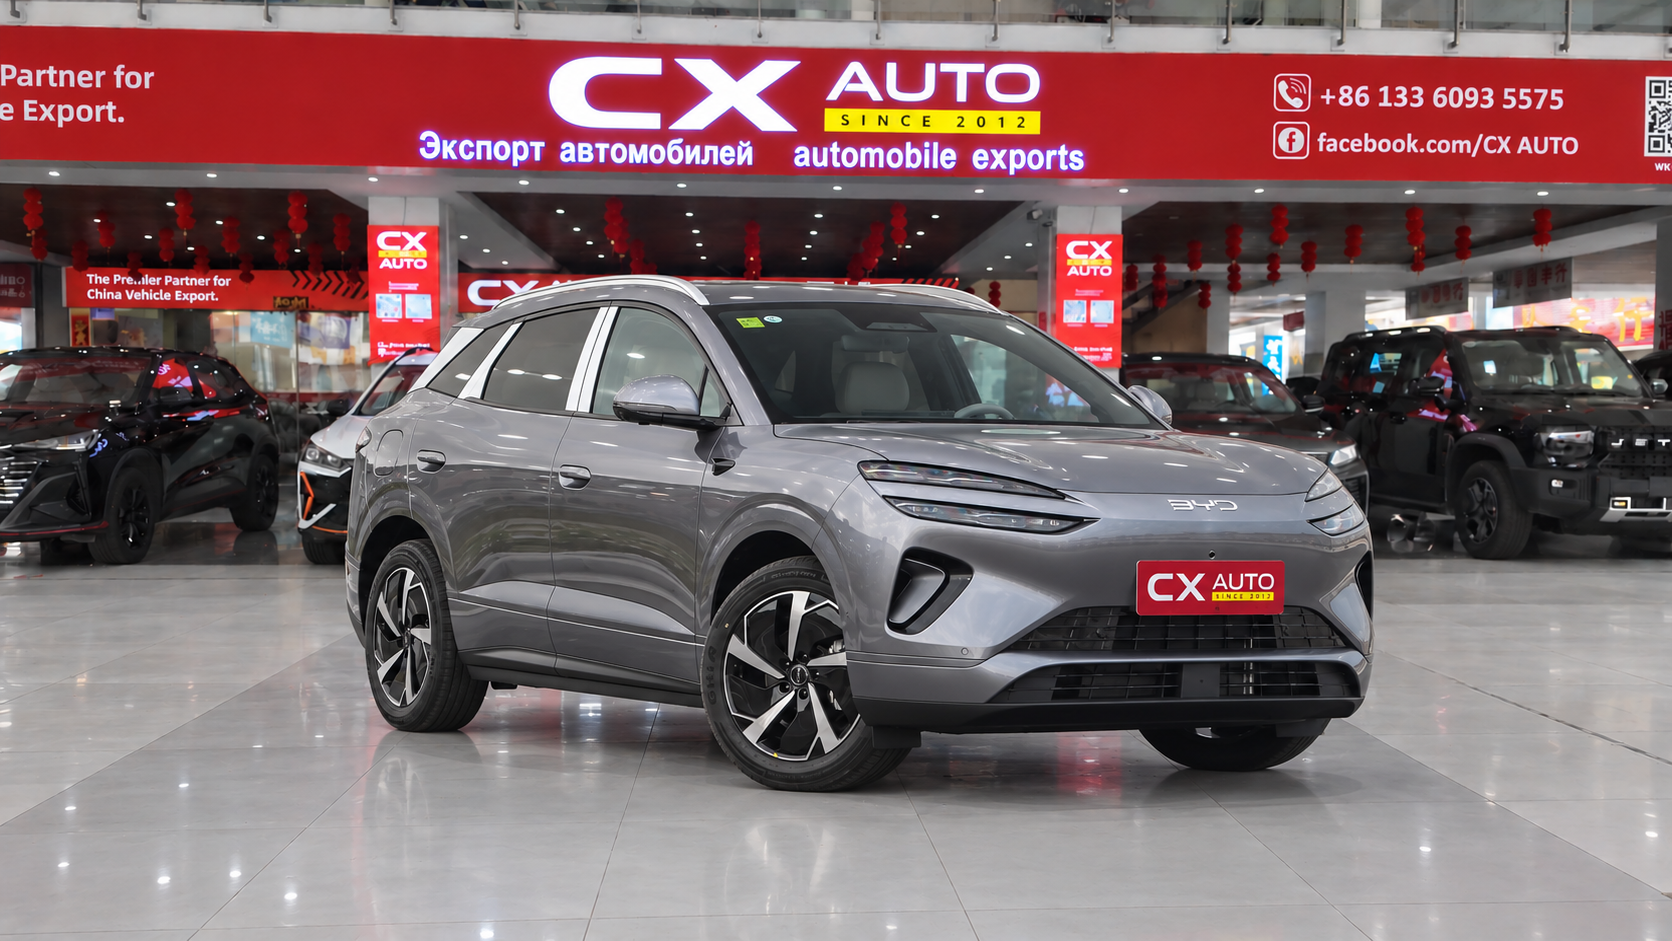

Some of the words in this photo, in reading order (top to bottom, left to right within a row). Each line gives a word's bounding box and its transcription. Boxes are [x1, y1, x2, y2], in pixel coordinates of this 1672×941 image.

[0, 64, 106, 89] Partner
[113, 64, 155, 89] for
[825, 61, 1041, 103] AUTO
[548, 56, 801, 132] CX
[1320, 85, 1370, 107] +86
[1378, 85, 1424, 107] 133
[1432, 86, 1495, 109] 6093
[1502, 87, 1564, 110] 5575
[23, 99, 125, 128] Export.
[840, 114, 932, 128] SINCE
[956, 115, 1027, 129] 2012
[418, 130, 546, 167] Экспорт
[559, 137, 754, 167] автомобилей
[1317, 132, 1511, 158] facebook.com/CX
[1516, 136, 1579, 155] AUTO
[793, 141, 957, 170] automobile
[972, 144, 1085, 176] exports
[1654, 162, 1672, 172] WK
[376, 230, 428, 251] CX
[1065, 240, 1113, 260] CX
[379, 257, 428, 270] AUTO
[1066, 265, 1113, 277] AUTO
[86, 273, 110, 285] The
[164, 275, 211, 287] Partner
[212, 274, 232, 287] for
[86, 288, 122, 300] China
[125, 289, 172, 301] Vehicle
[174, 290, 219, 304] Export.
[1167, 498, 1239, 511] BYD
[1147, 572, 1206, 602] CX
[1212, 573, 1275, 591] AUTO
